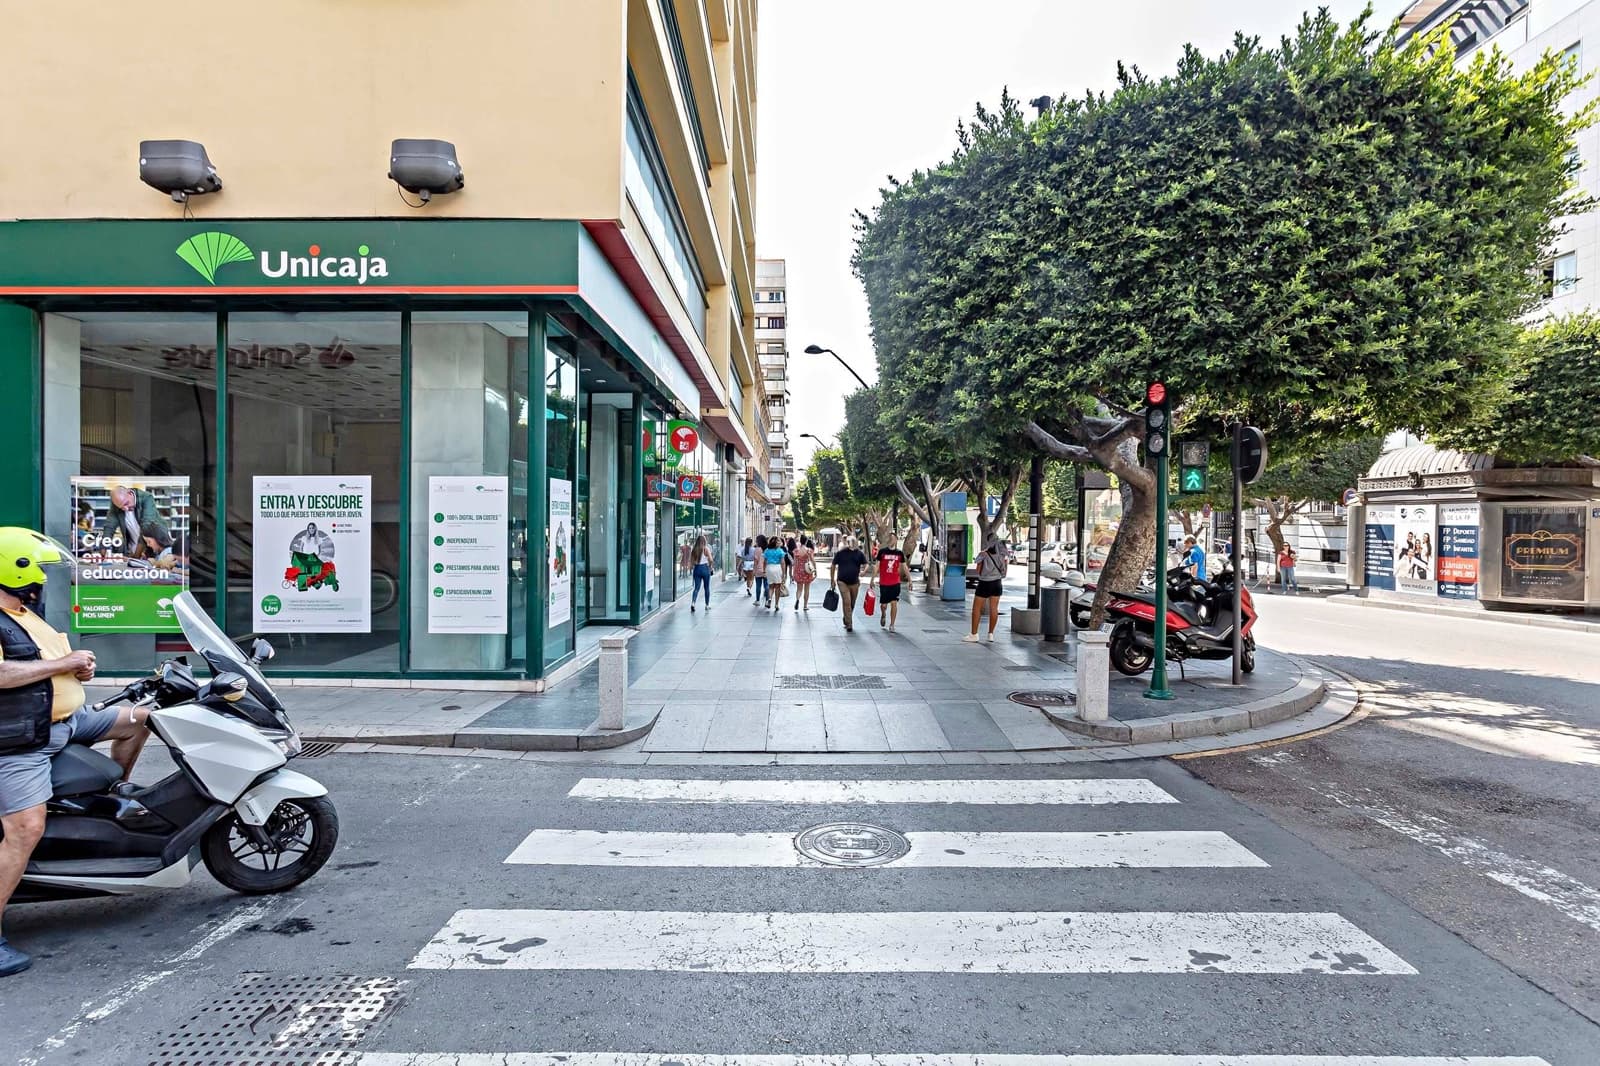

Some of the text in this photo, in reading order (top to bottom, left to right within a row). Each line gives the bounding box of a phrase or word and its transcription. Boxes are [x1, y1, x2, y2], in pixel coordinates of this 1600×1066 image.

[260, 244, 389, 285] Unicaja
[260, 495, 363, 509] ENTRA Y DESCUBRE
[1442, 527, 1451, 535] FP
[82, 533, 123, 548] Creo
[1442, 535, 1451, 543] FP
[1442, 544, 1451, 552] FP
[1516, 547, 1569, 555] PREMIUM
[82, 551, 101, 563] en
[82, 565, 169, 579] educación
[264, 604, 279, 612] Uni
